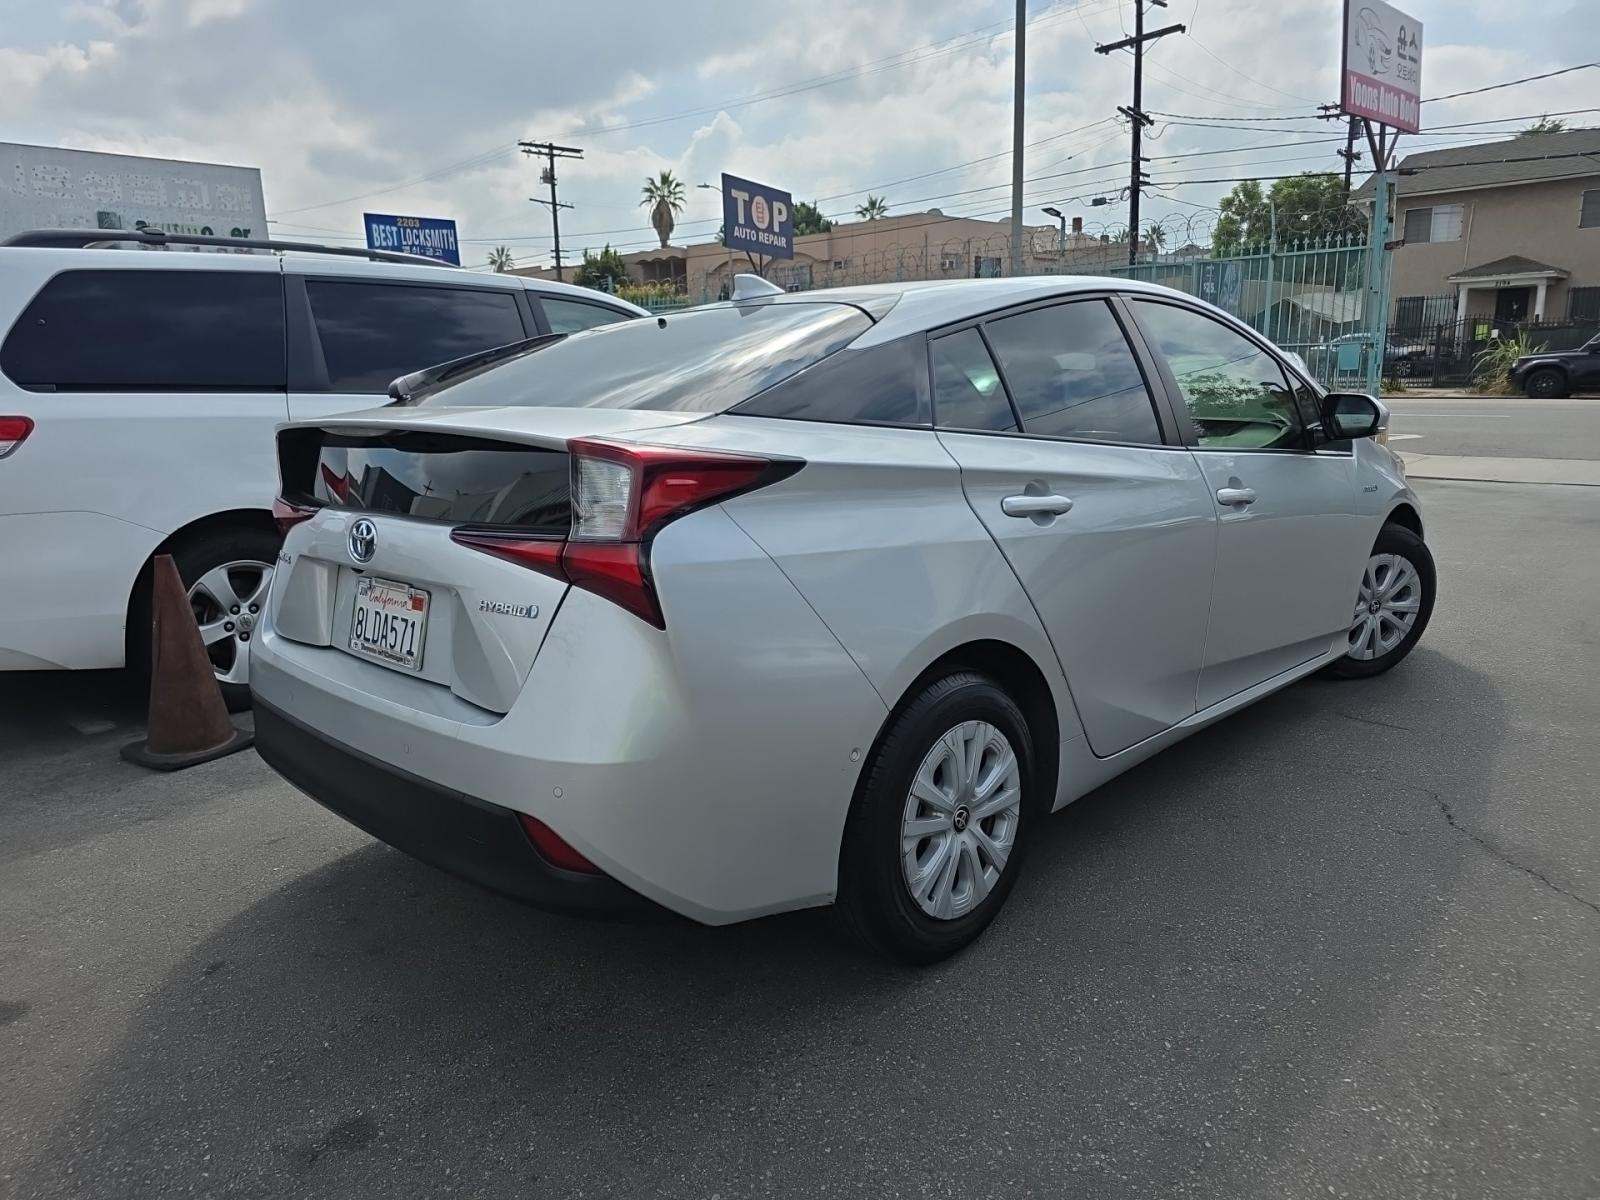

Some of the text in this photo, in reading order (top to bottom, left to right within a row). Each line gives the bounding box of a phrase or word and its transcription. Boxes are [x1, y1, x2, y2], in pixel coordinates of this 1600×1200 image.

[1350, 75, 1418, 128] Yoons Auto Body
[397, 217, 420, 228] 2203
[731, 188, 788, 233] TOP
[371, 223, 456, 251] BEST LOCKSMITH
[734, 226, 787, 249] AUTO REPAIR
[369, 587, 408, 610] California
[479, 599, 529, 618] HYBRID
[355, 606, 416, 656] 8LDA571
